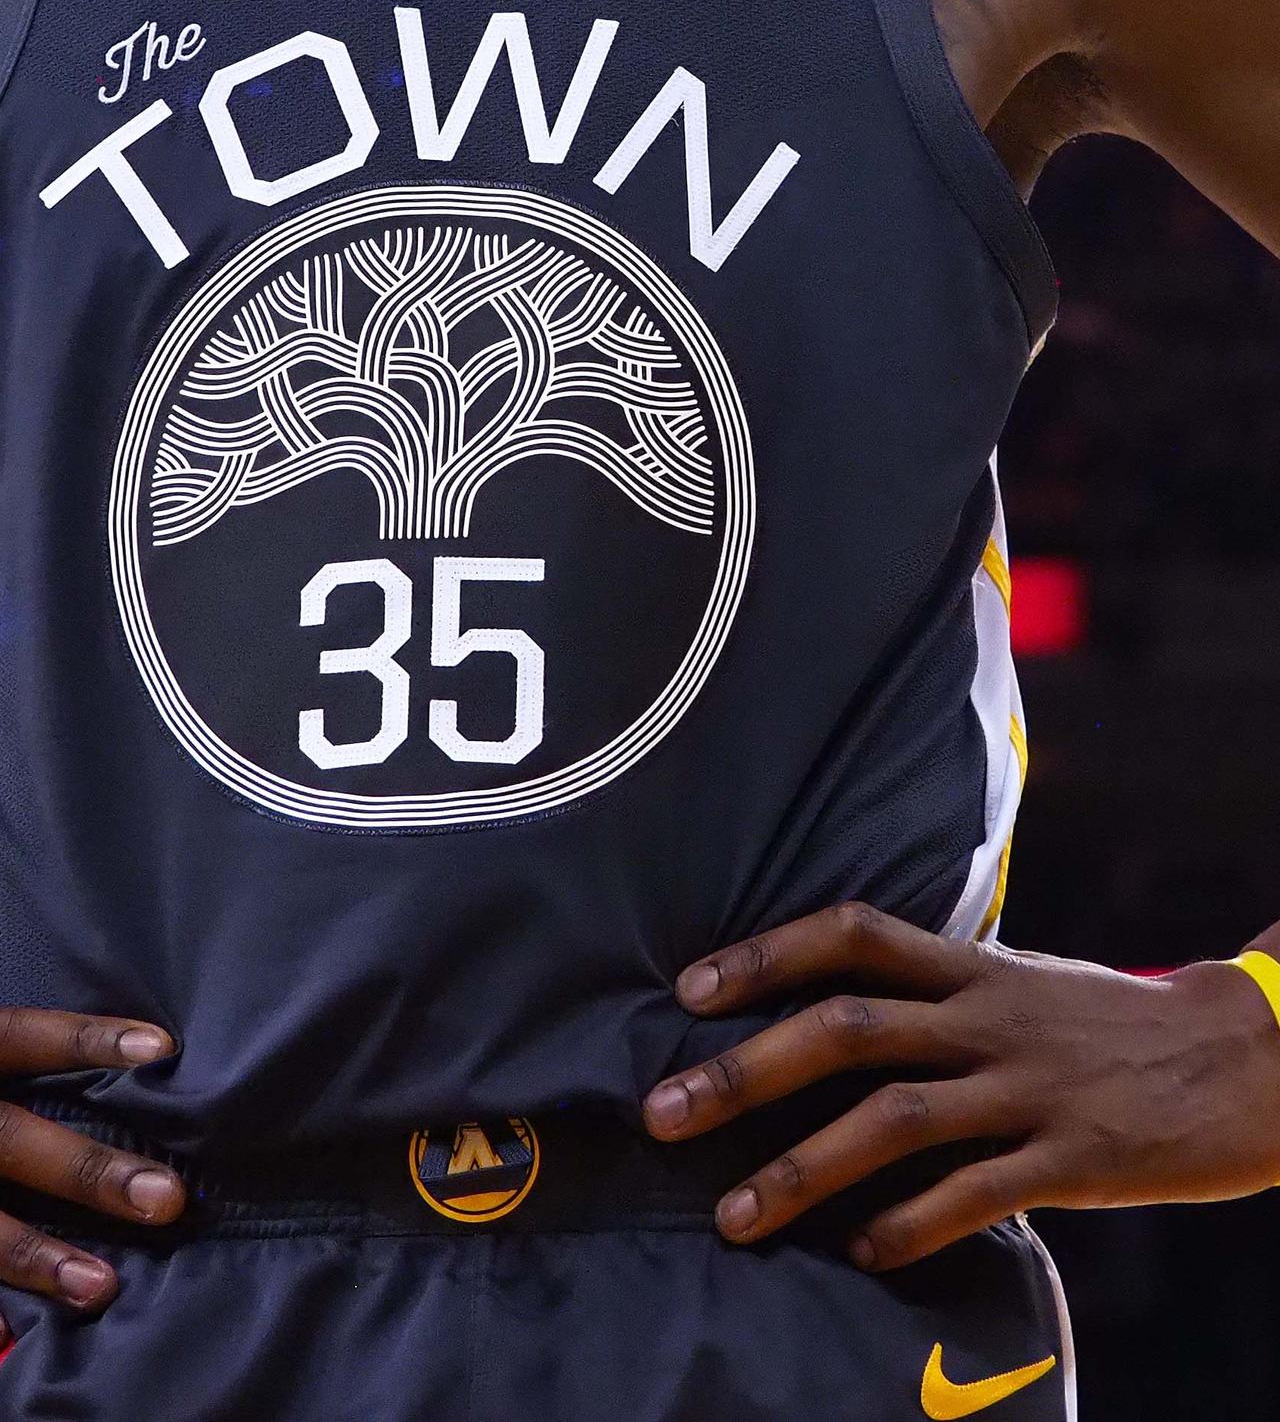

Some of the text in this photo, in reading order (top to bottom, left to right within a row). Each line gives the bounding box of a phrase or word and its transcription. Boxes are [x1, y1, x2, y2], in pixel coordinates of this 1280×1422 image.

[39, 5, 801, 272] TOWN
[98, 20, 207, 104] The
[298, 556, 546, 770] 35
